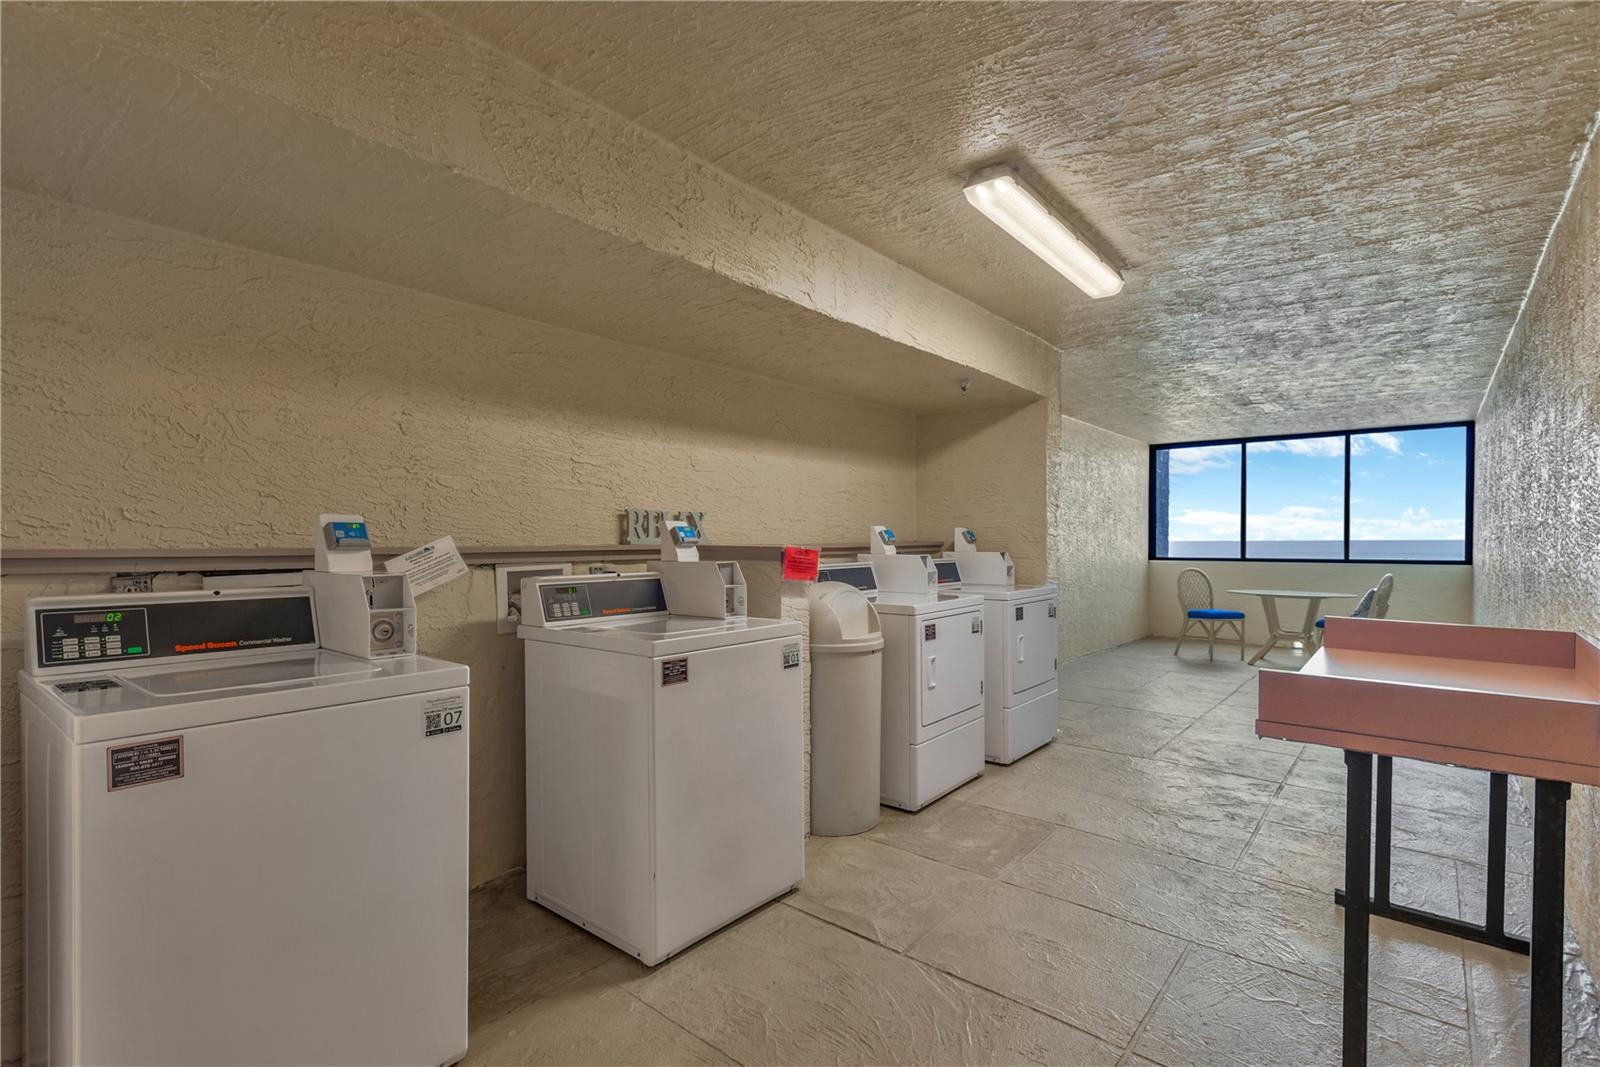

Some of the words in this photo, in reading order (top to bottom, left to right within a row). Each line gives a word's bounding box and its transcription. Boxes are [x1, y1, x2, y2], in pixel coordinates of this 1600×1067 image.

[624, 508, 708, 545] REX
[106, 612, 122, 622] 02
[175, 643, 206, 652] Speed
[207, 641, 237, 649] Queen
[790, 653, 799, 663] 01
[444, 710, 462, 726] 07
